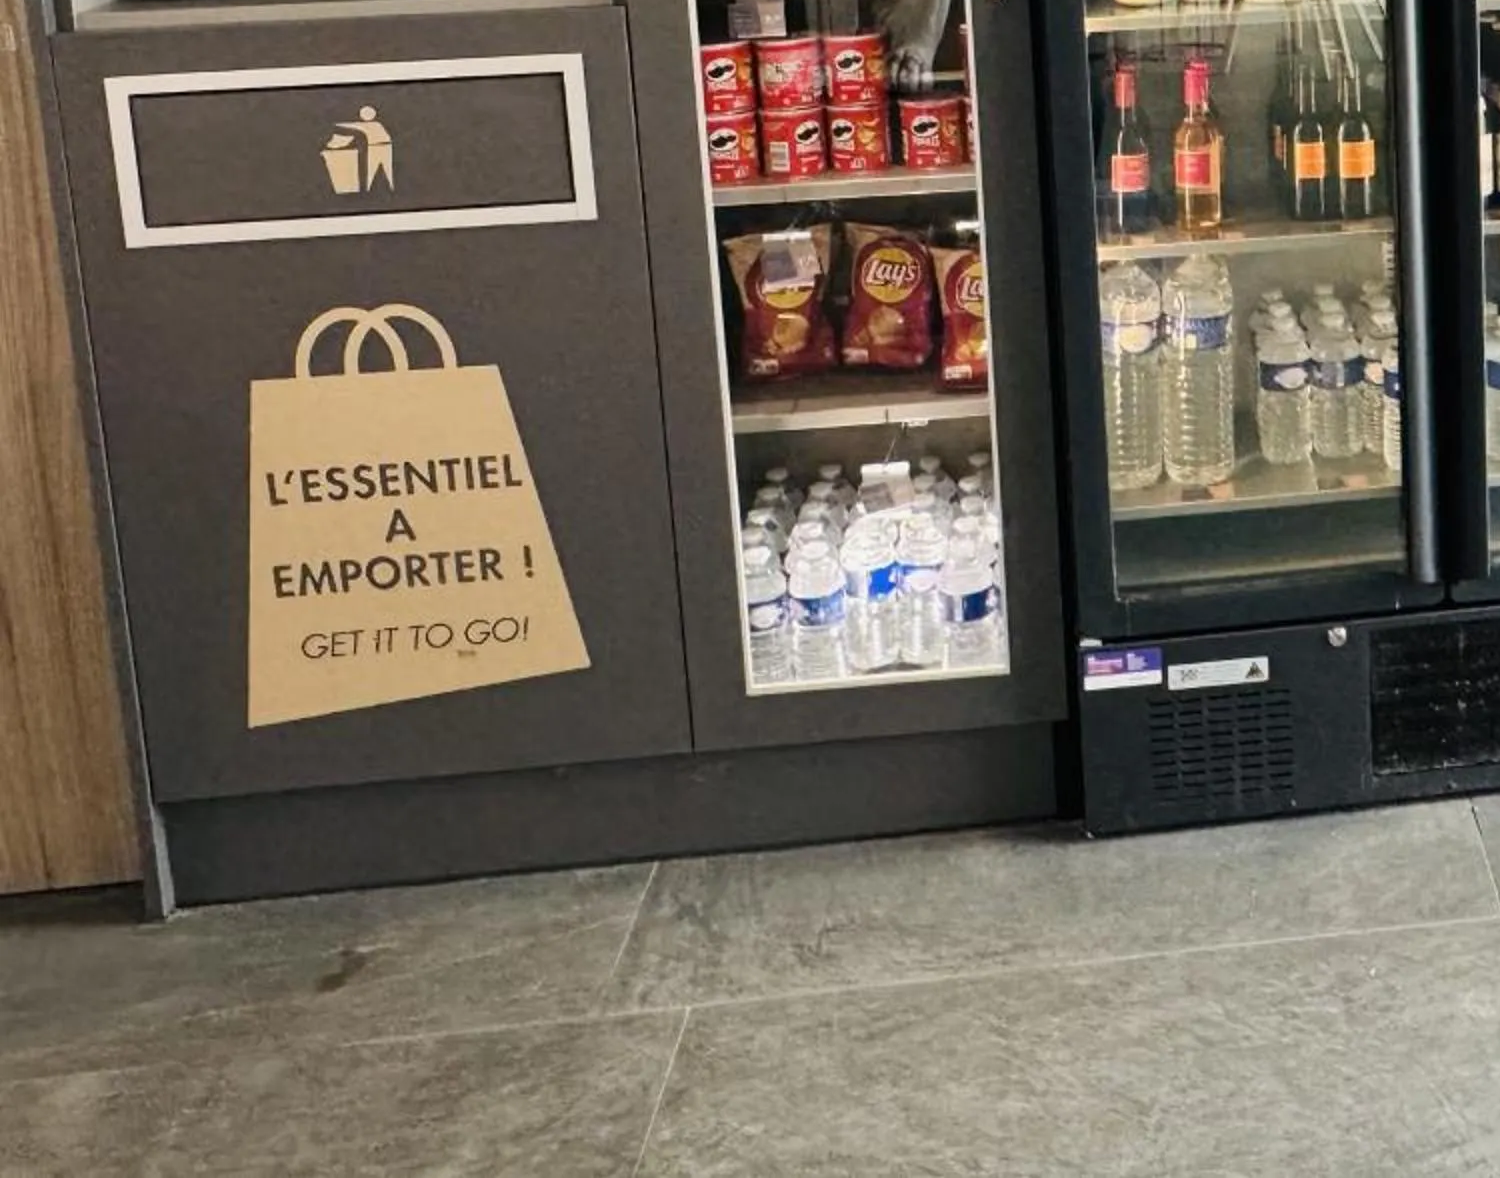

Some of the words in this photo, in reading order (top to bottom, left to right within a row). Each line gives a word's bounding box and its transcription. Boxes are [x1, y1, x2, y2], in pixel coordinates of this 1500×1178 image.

[865, 258, 918, 289] Lay's
[265, 453, 523, 507] L'ESSENTIEL
[384, 508, 417, 543] A
[272, 548, 504, 598] EMPORTER
[301, 629, 364, 660] GET
[373, 626, 400, 655] IT
[408, 622, 453, 652] TO
[463, 616, 530, 647] GO!
